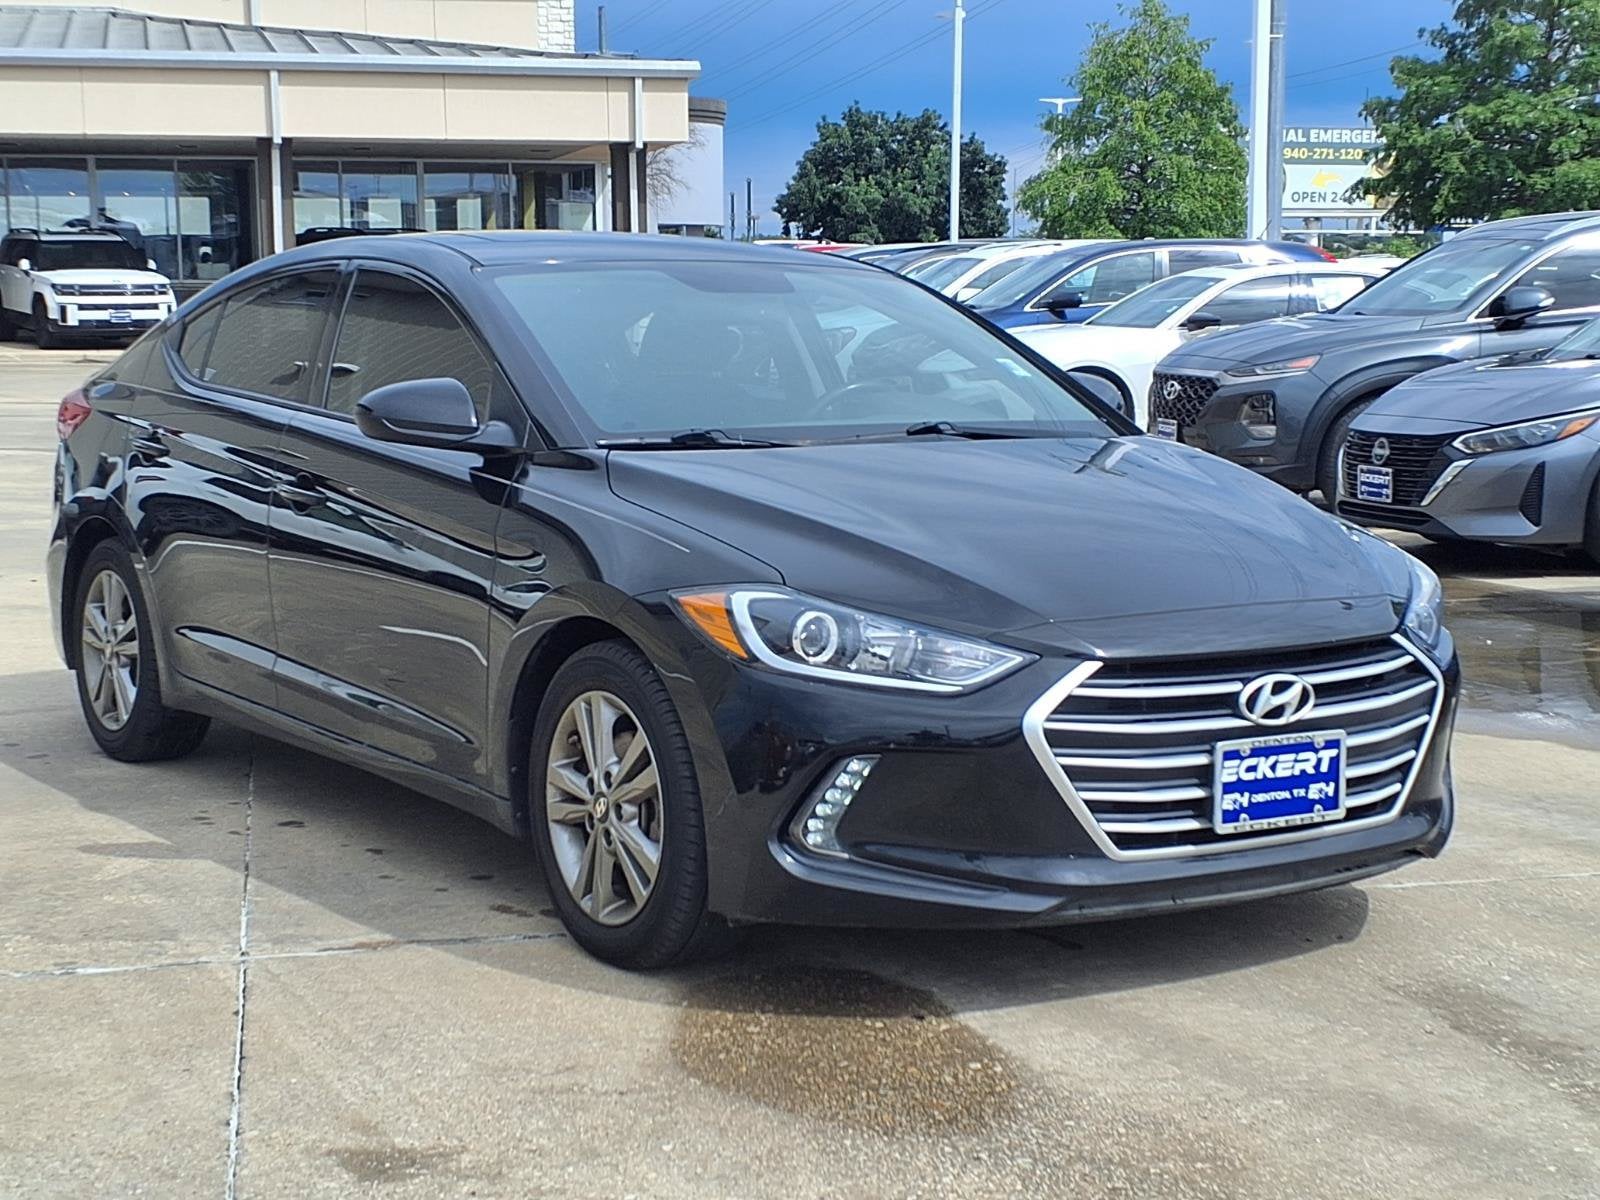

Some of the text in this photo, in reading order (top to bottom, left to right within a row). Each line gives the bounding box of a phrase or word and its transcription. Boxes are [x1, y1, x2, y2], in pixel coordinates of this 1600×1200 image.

[1283, 147, 1363, 160] 940-271-120
[1291, 191, 1327, 203] OPEN
[1221, 749, 1339, 783] ECKERT
[1292, 788, 1307, 798] TX
